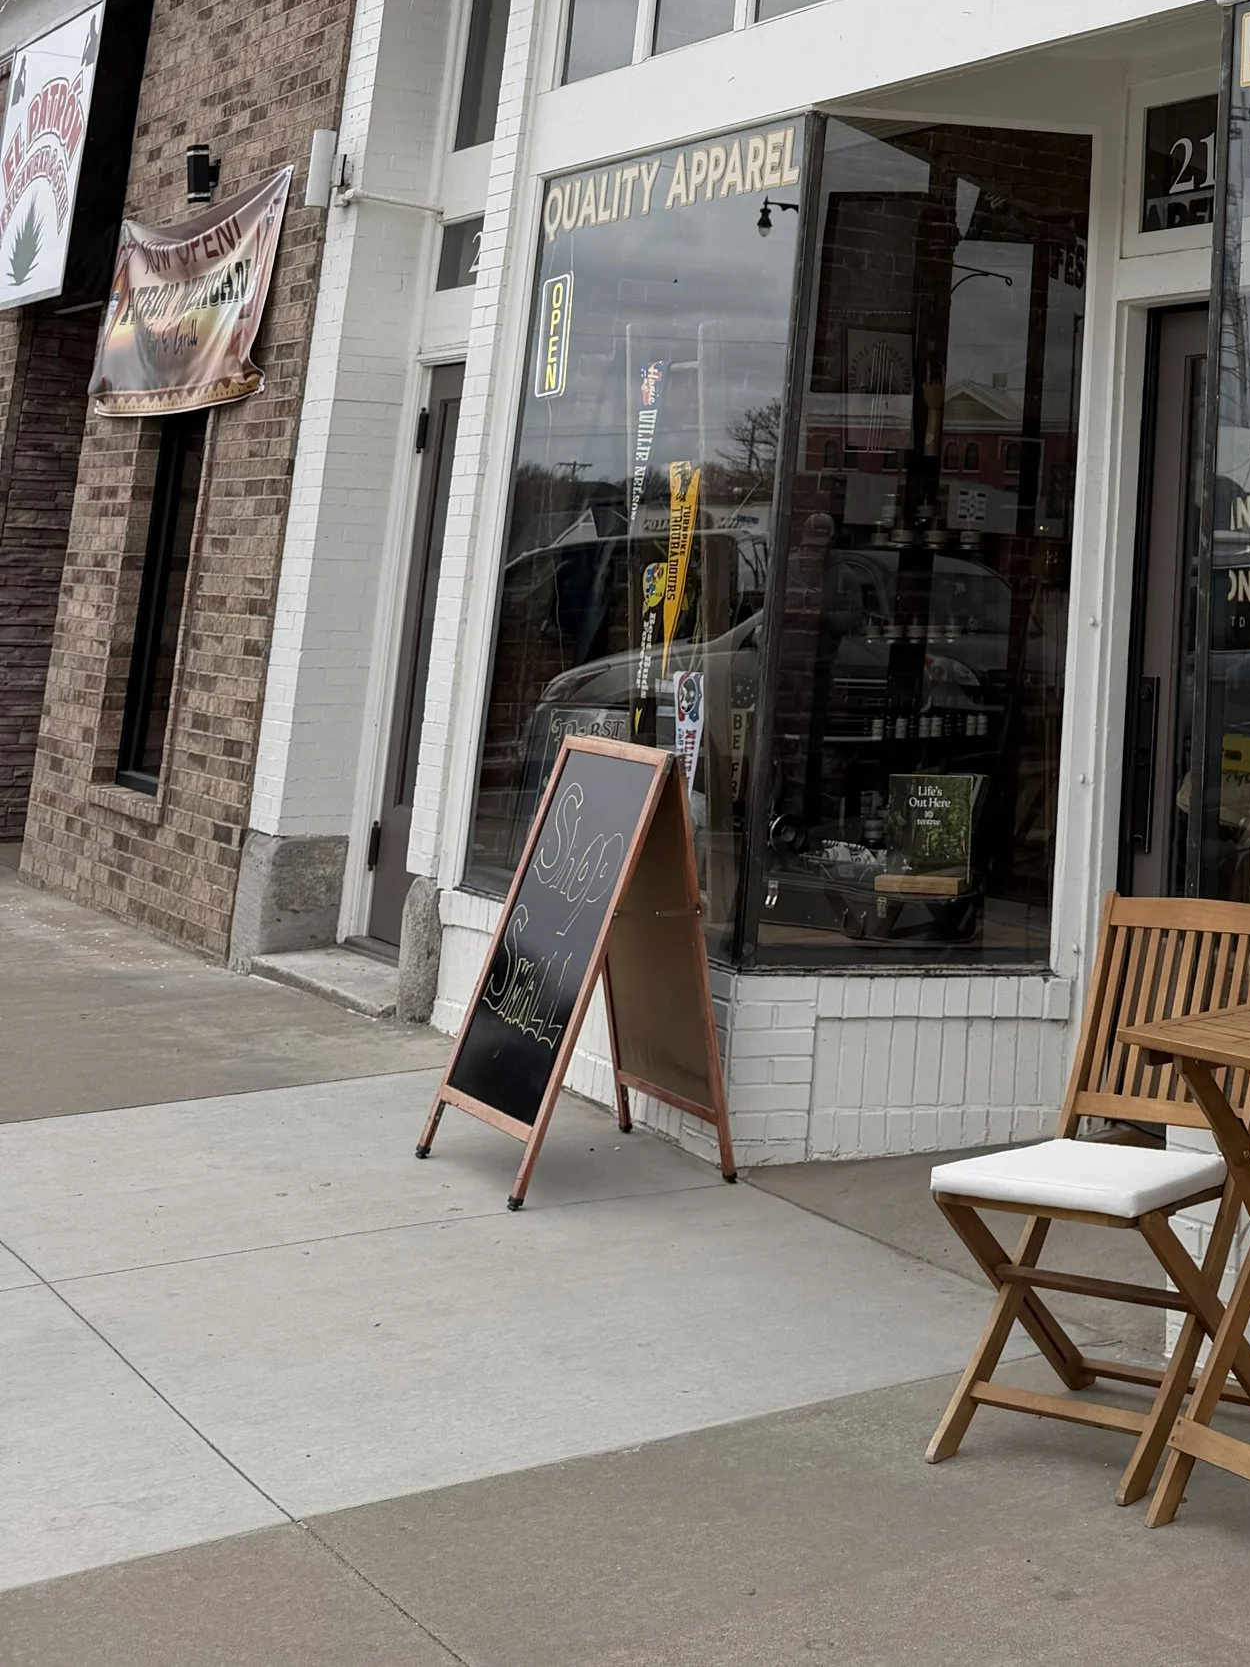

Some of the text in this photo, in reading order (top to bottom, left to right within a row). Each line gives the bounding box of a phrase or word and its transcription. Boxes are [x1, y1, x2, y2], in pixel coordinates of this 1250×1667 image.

[3, 72, 85, 194] EL PATRÓN
[543, 126, 800, 243] QUALITY APPAREL
[142, 241, 172, 275] NOW
[174, 317, 199, 356] Grill
[545, 282, 563, 390] OPEN
[635, 408, 658, 462] WILLIE
[630, 465, 647, 521] NELSON
[666, 507, 683, 602] TROUBADOURS
[679, 505, 692, 557] TURNPIKE
[908, 797, 951, 809] Out Here
[917, 785, 943, 797] Life's
